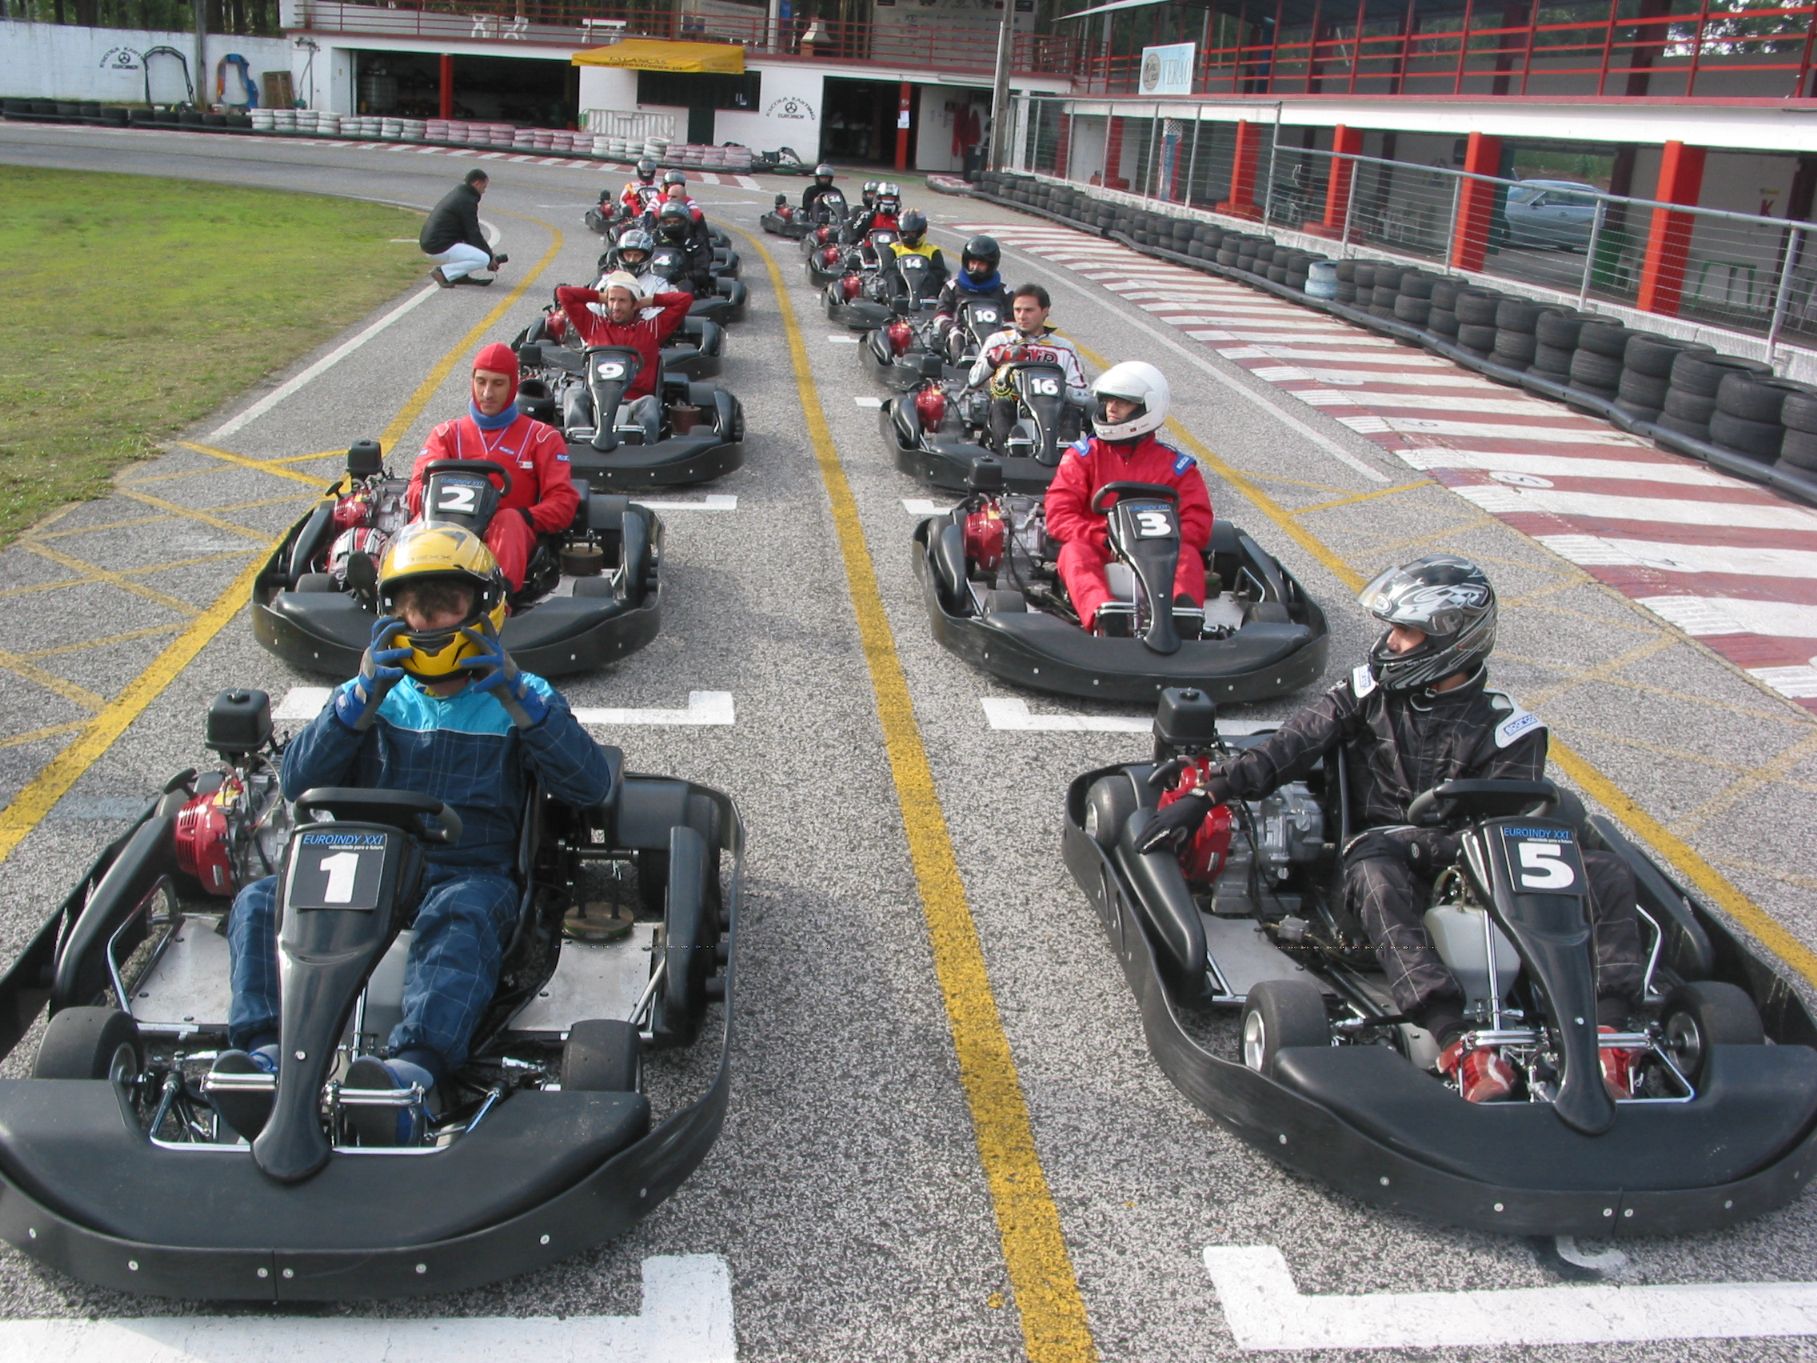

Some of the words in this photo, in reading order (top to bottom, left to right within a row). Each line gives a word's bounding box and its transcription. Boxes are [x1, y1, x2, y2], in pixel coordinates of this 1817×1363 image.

[905, 258, 921, 269] 14
[975, 310, 997, 323] 10
[597, 363, 624, 379] 9
[1031, 378, 1058, 395] 16
[438, 486, 475, 512] 2
[1136, 512, 1172, 537] 3
[303, 834, 361, 845] EUROINDY
[362, 835, 384, 845] XXI
[1503, 827, 1551, 838] EUROINDY
[1553, 830, 1569, 840] XXI
[1518, 842, 1575, 889] 5
[320, 852, 359, 903] 1
